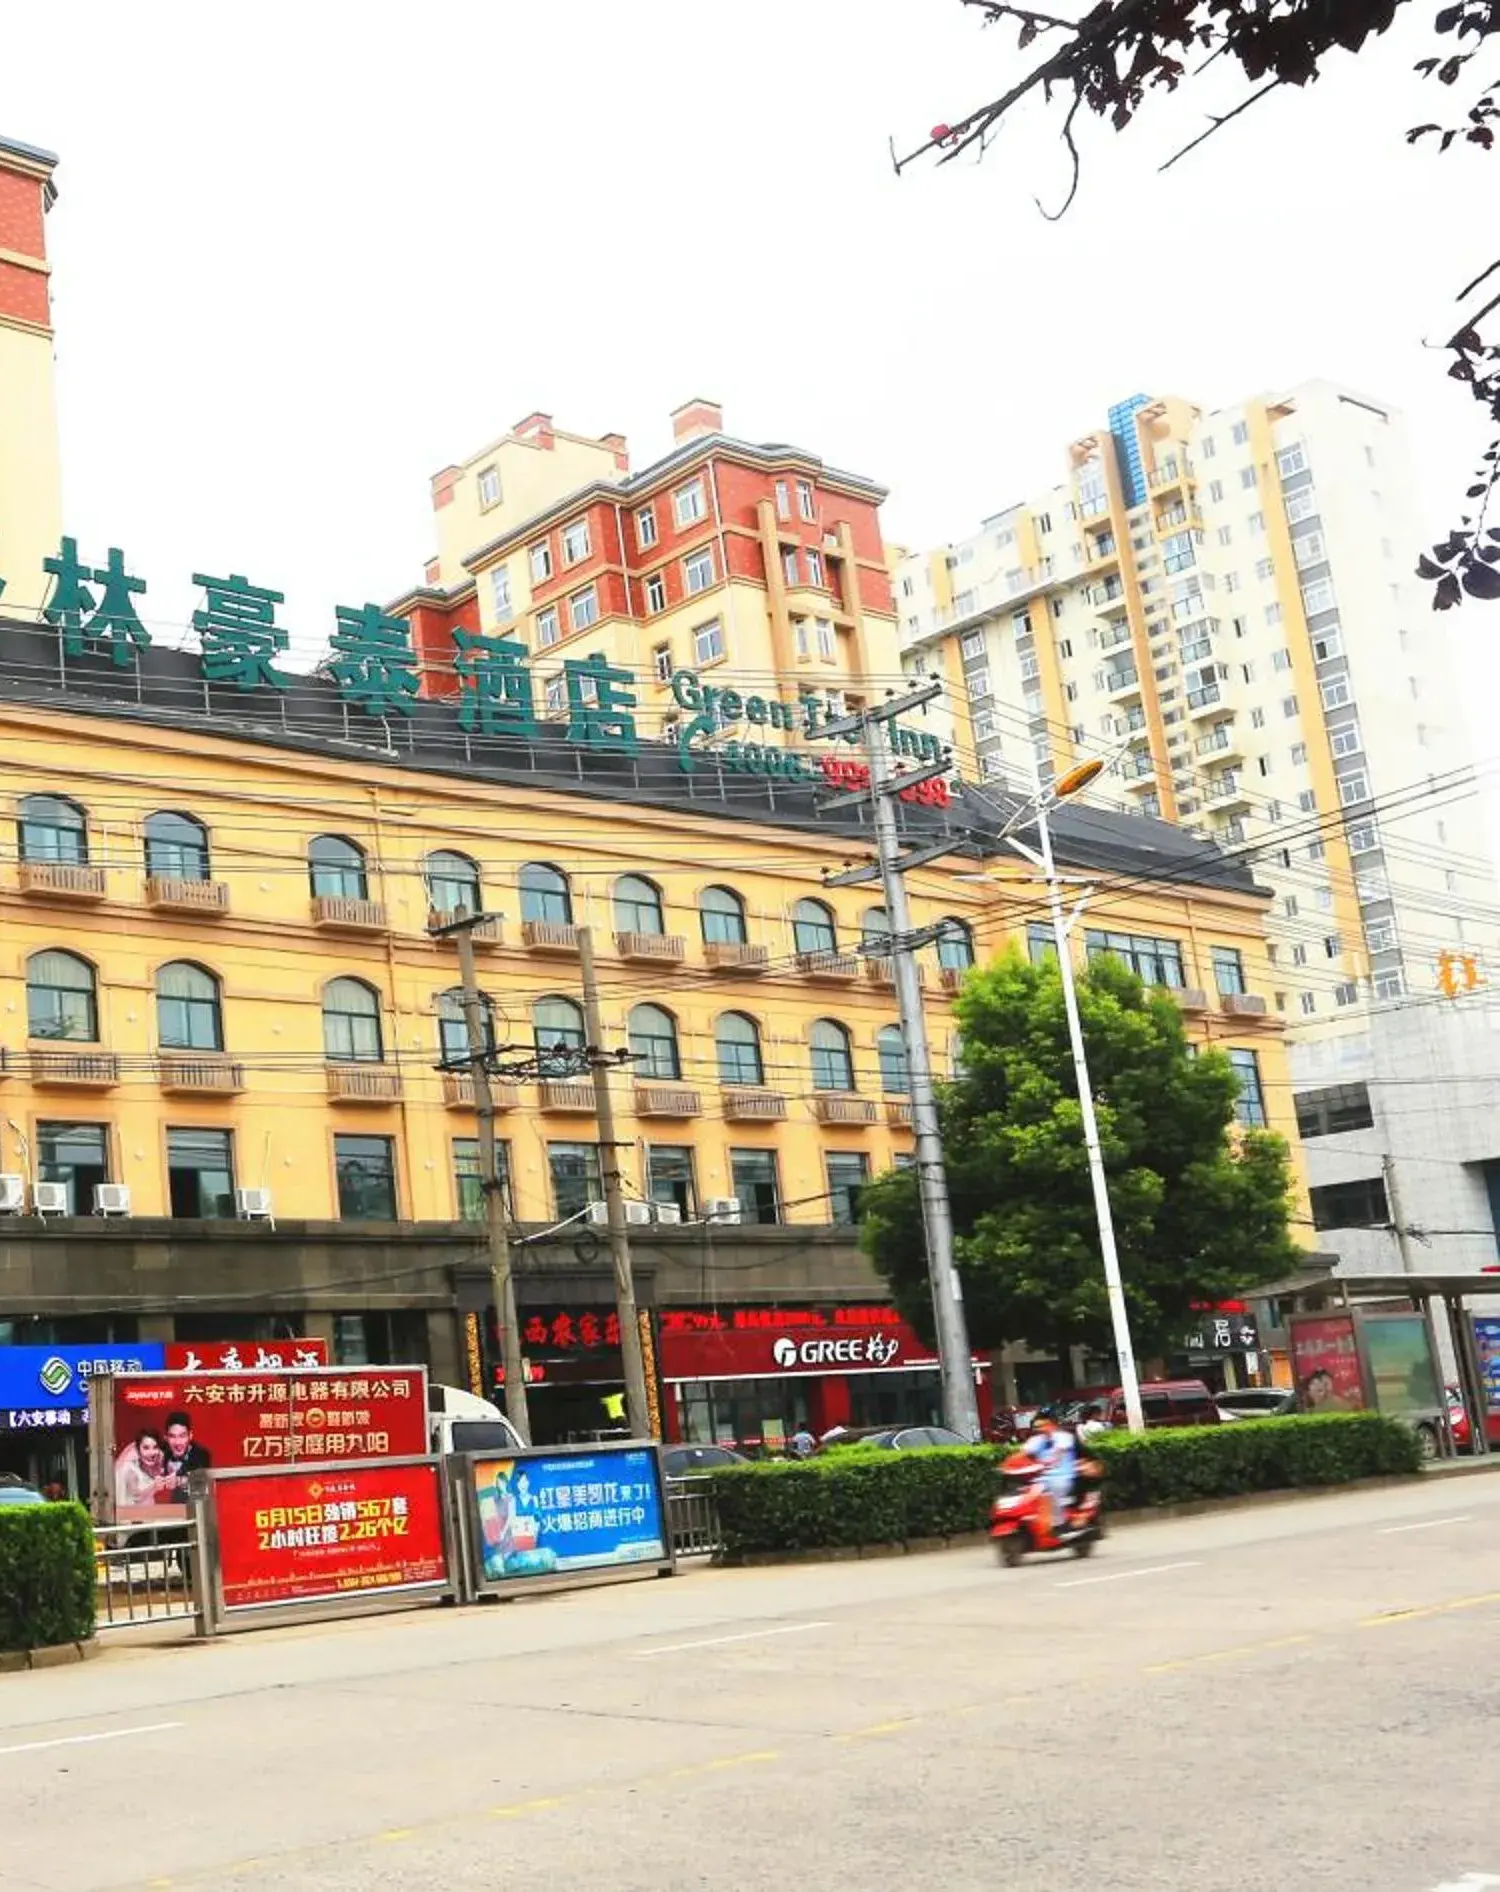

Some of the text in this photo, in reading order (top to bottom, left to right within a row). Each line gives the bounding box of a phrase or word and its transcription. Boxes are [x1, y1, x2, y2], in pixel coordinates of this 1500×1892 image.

[672, 669, 793, 731] Green
[801, 1338, 863, 1364] GREE
[77, 1358, 143, 1377] 中国移动
[184, 1379, 411, 1404] 六安市升源电器有限公司
[243, 1432, 389, 1457] 亿万家庭用九阳
[542, 1506, 645, 1533] 火爆招商进行中
